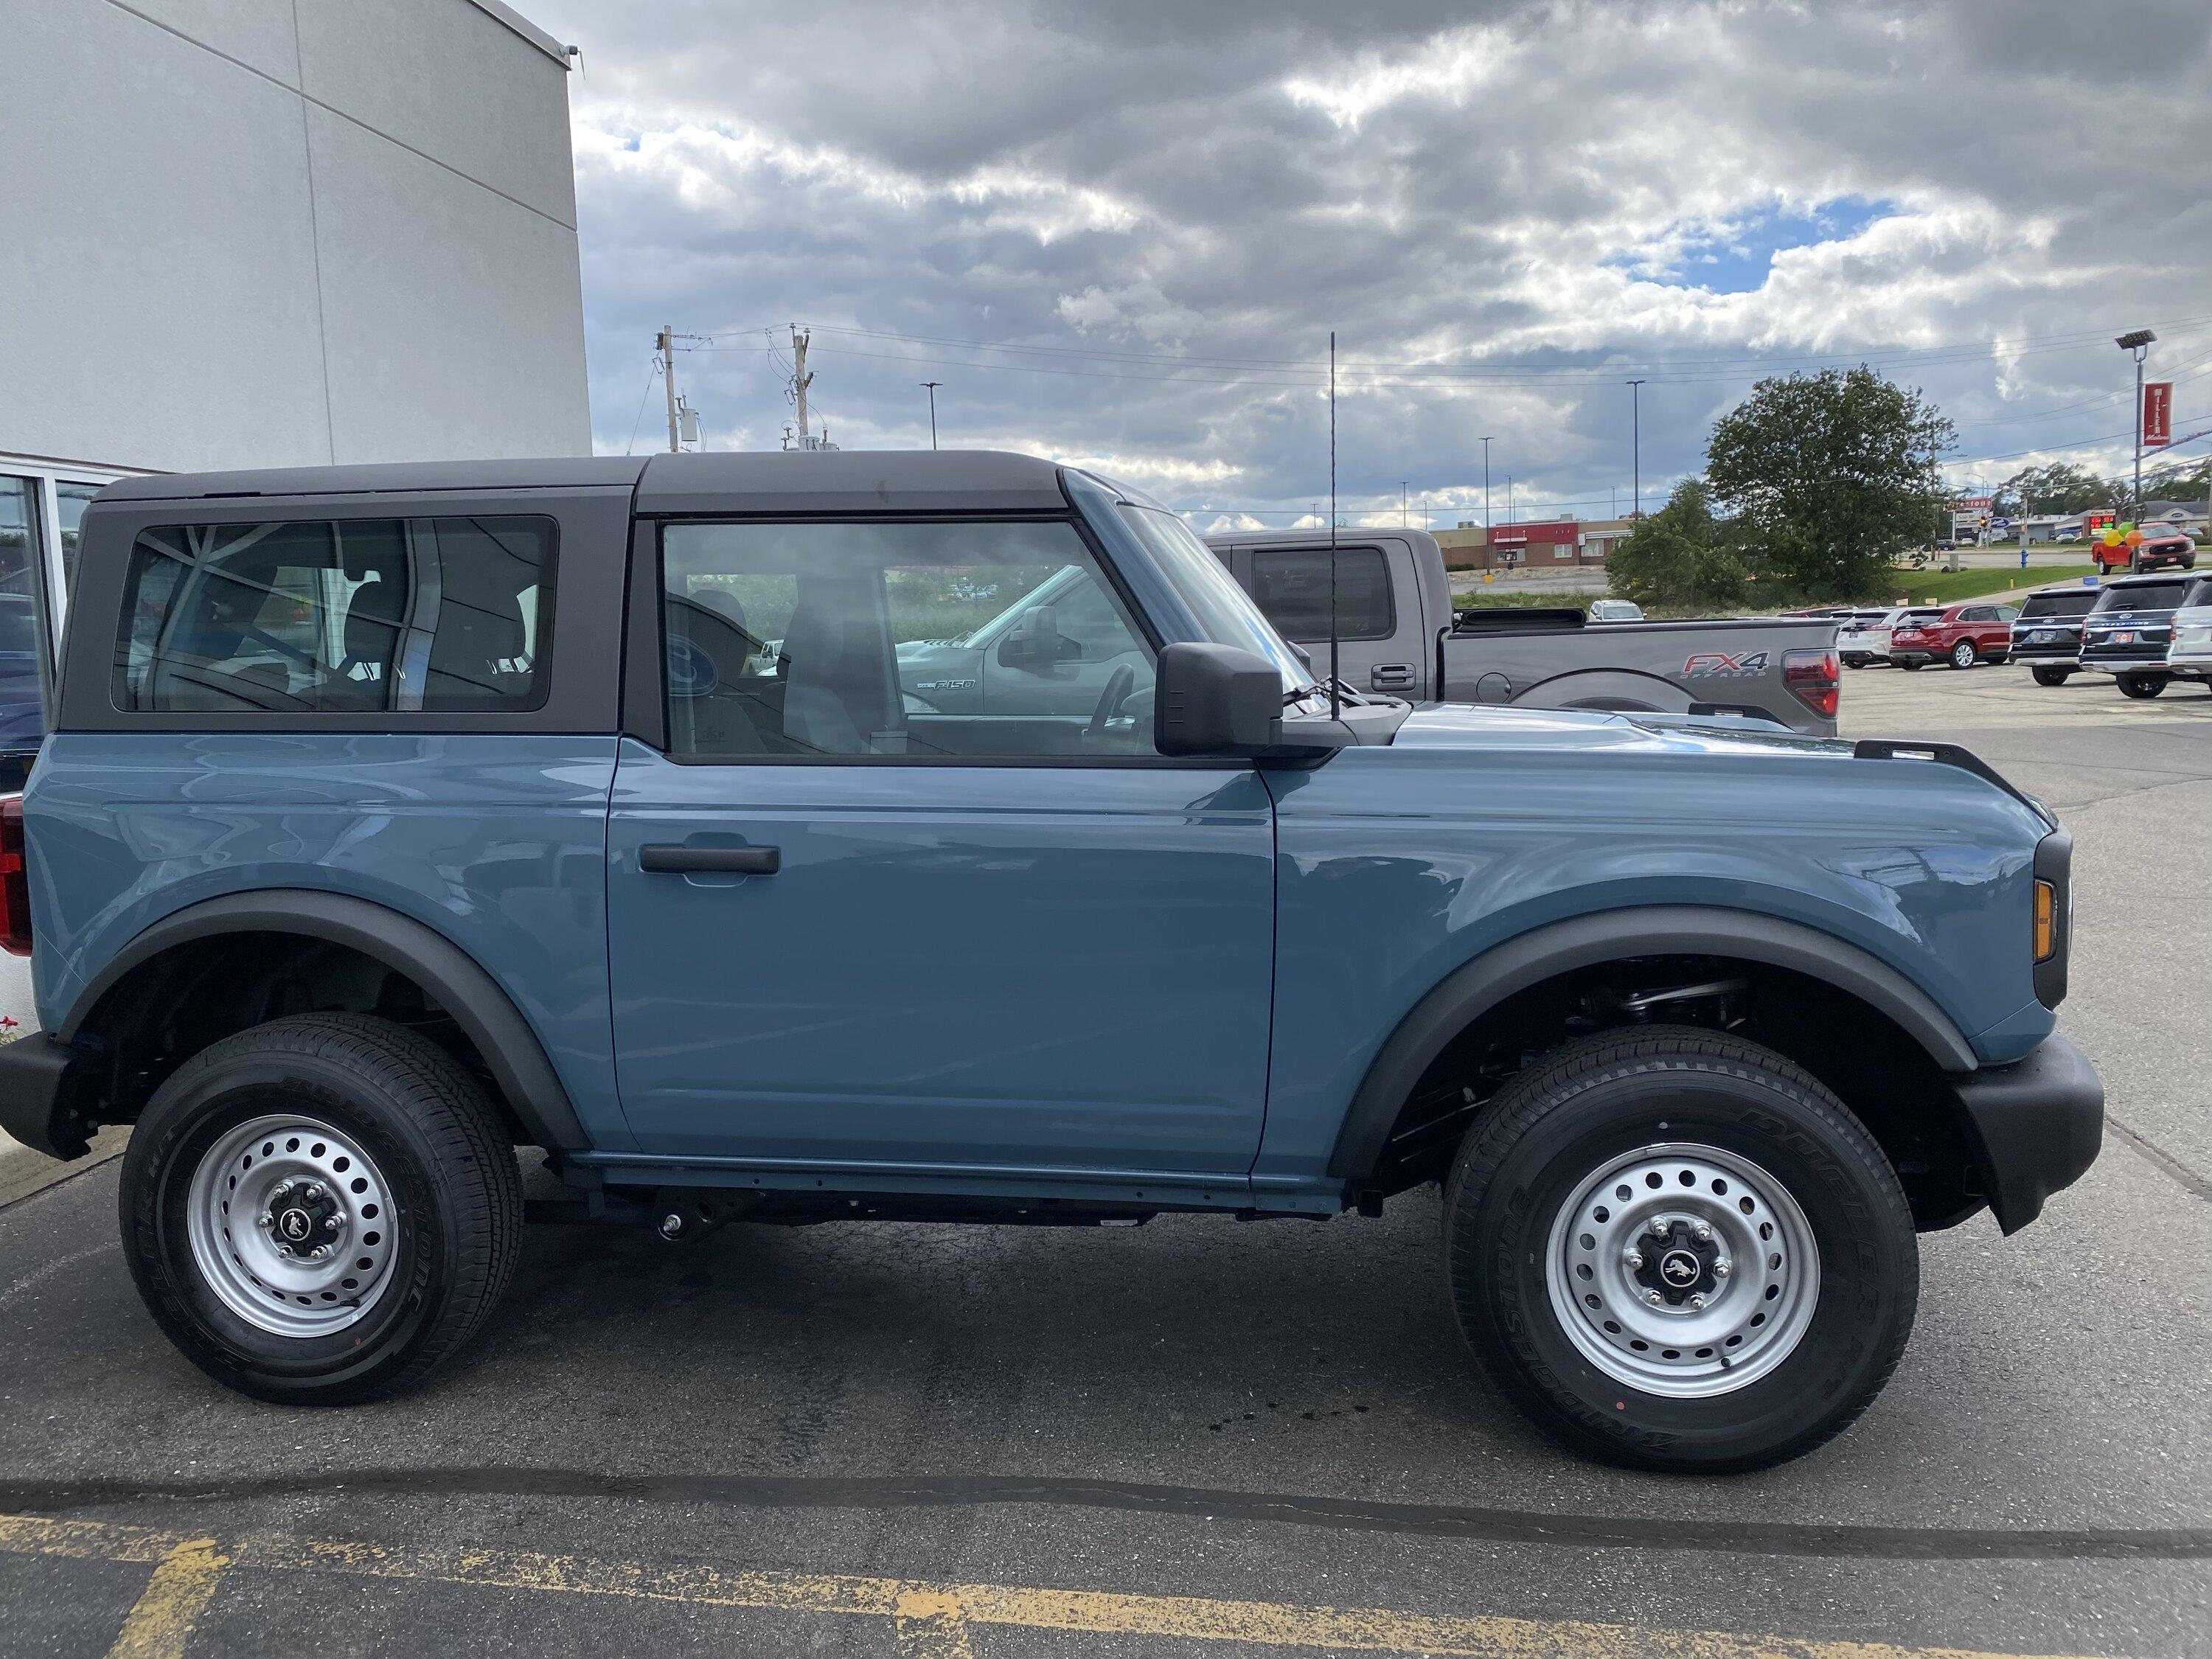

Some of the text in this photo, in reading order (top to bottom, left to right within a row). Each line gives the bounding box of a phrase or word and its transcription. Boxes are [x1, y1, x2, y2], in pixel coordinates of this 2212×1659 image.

[933, 679, 976, 690] F-150
[1682, 651, 1770, 673] FX4
[1736, 1106, 1879, 1329] DUELER
[1496, 1182, 1682, 1452] BRIDGESTONE
